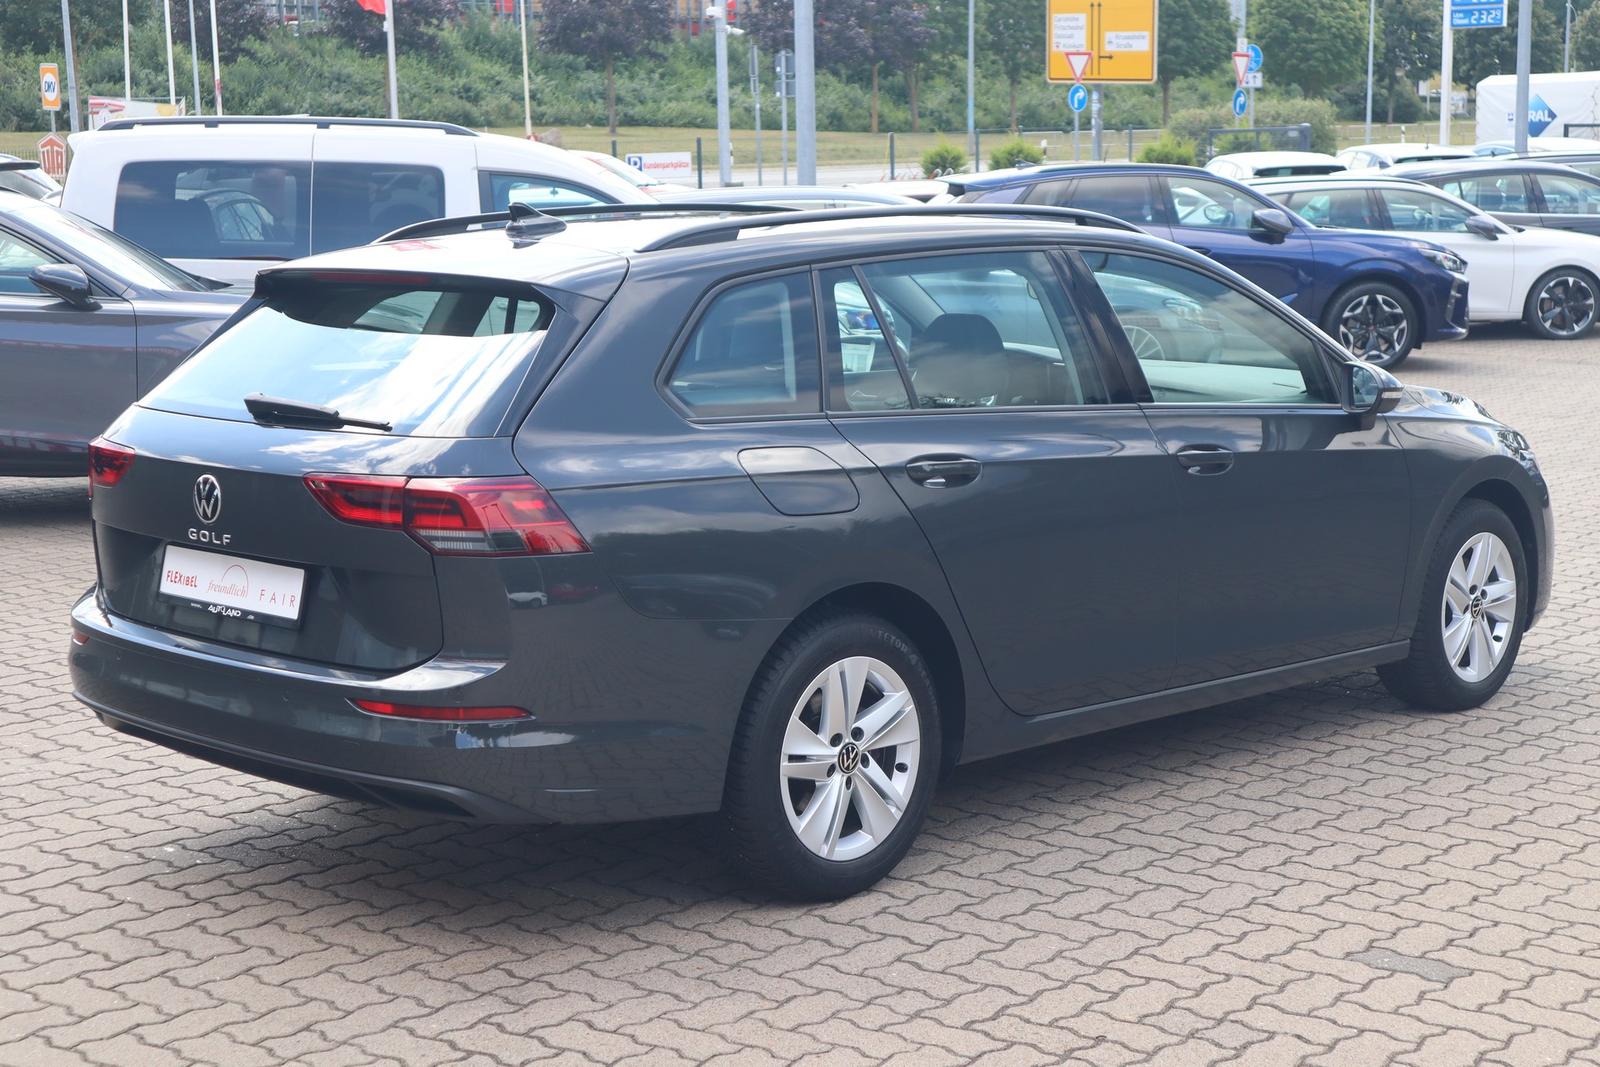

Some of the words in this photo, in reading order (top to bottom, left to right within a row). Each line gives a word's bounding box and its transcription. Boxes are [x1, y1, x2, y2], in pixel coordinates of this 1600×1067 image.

[188, 528, 232, 545] GOLF
[166, 570, 198, 588] FLEXIBEL
[207, 580, 247, 598] freundlich
